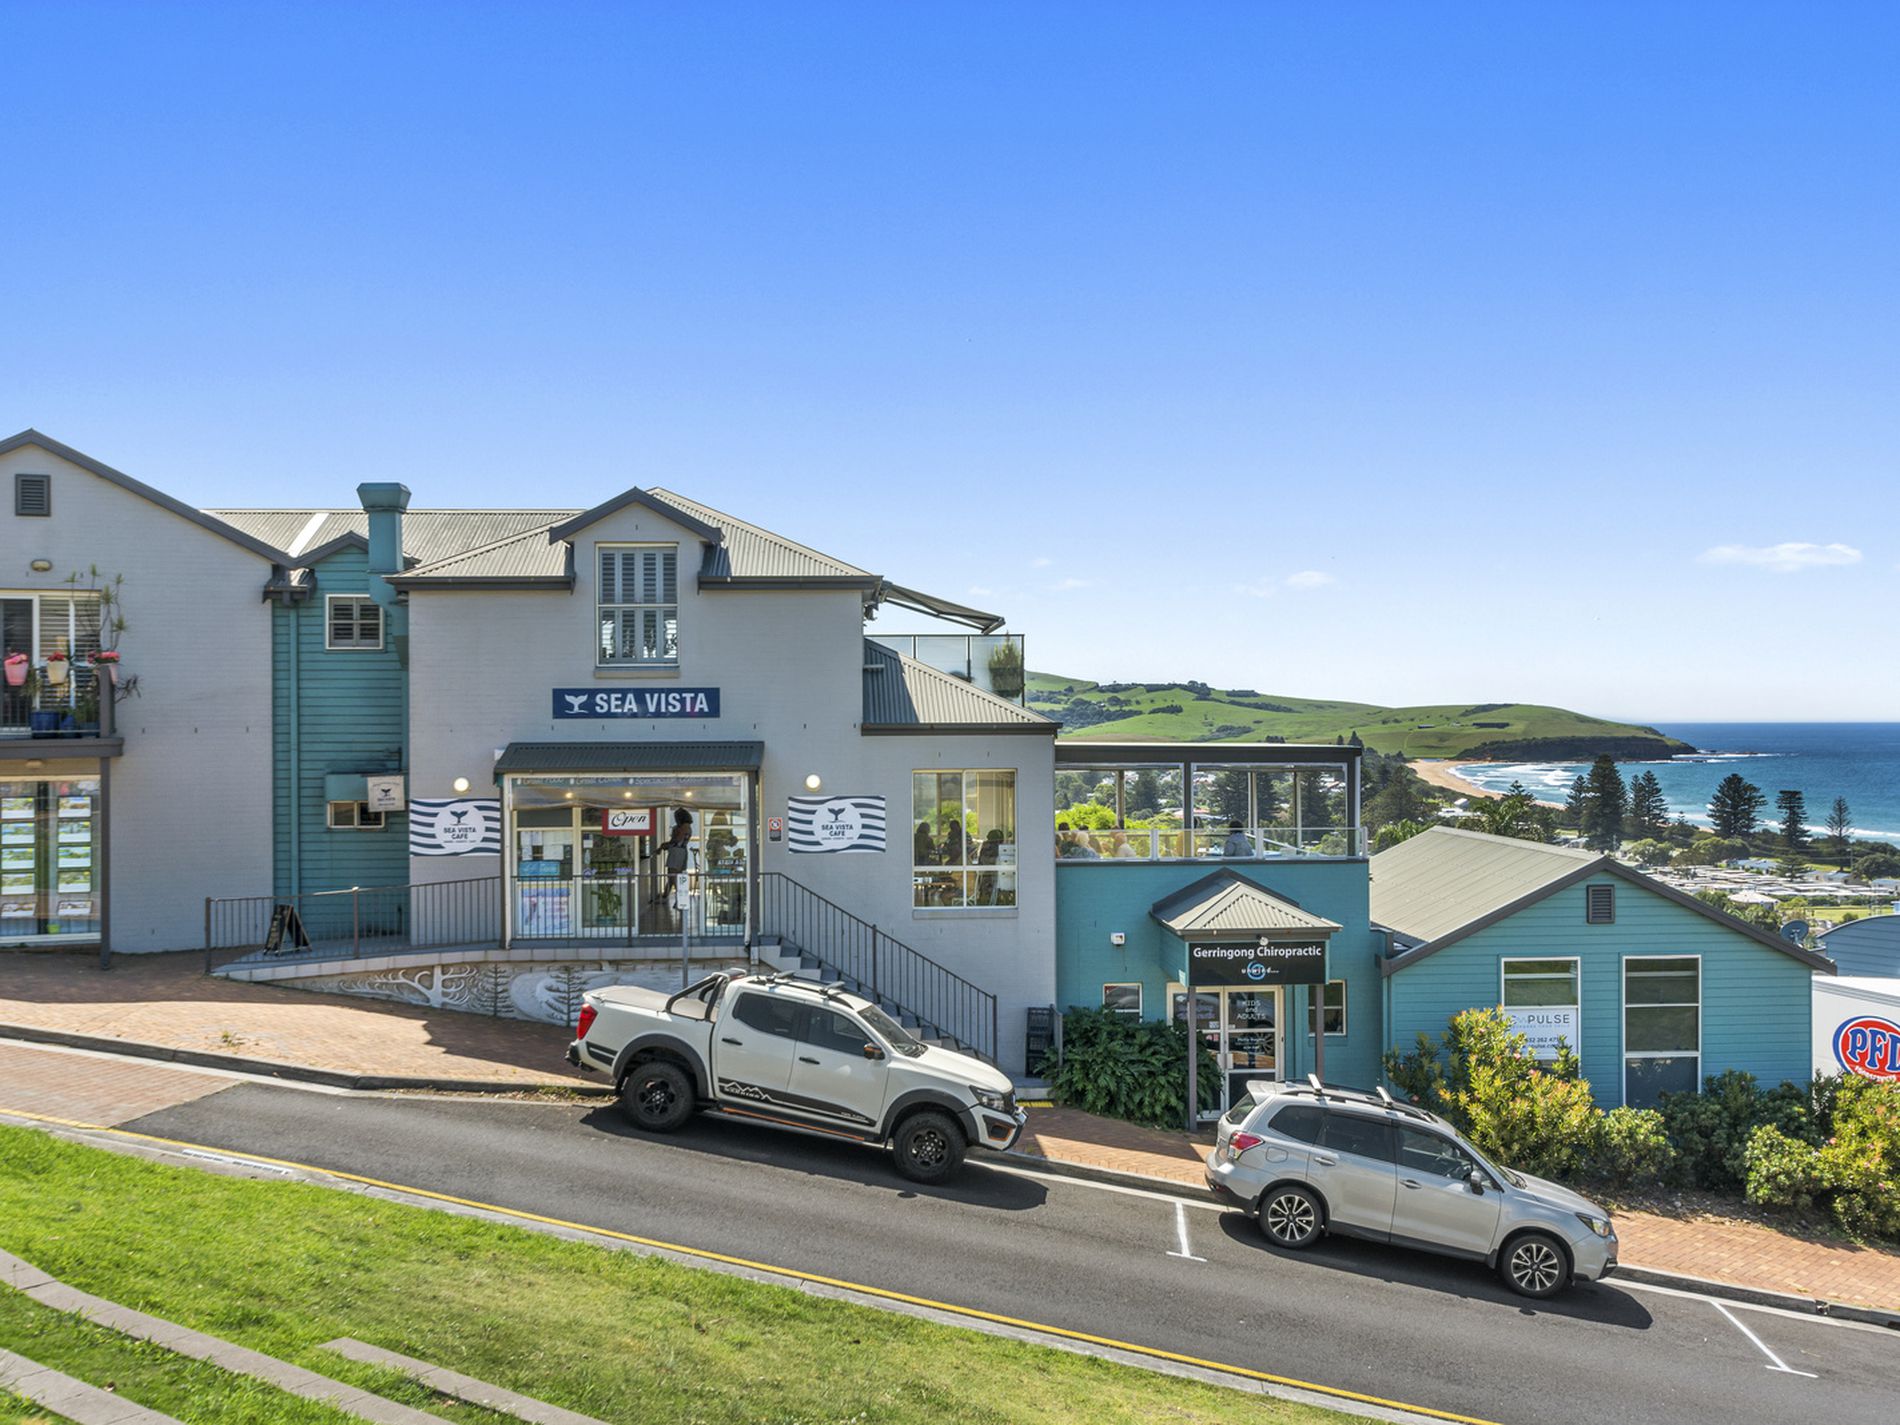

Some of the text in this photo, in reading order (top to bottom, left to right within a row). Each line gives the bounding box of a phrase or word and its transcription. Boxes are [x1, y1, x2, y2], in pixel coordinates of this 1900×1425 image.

[595, 692, 710, 713] SEA VISTA
[611, 811, 647, 828] Open
[1193, 945, 1322, 960] Gerringong Chiropractic
[1527, 1014, 1570, 1024] PULSE
